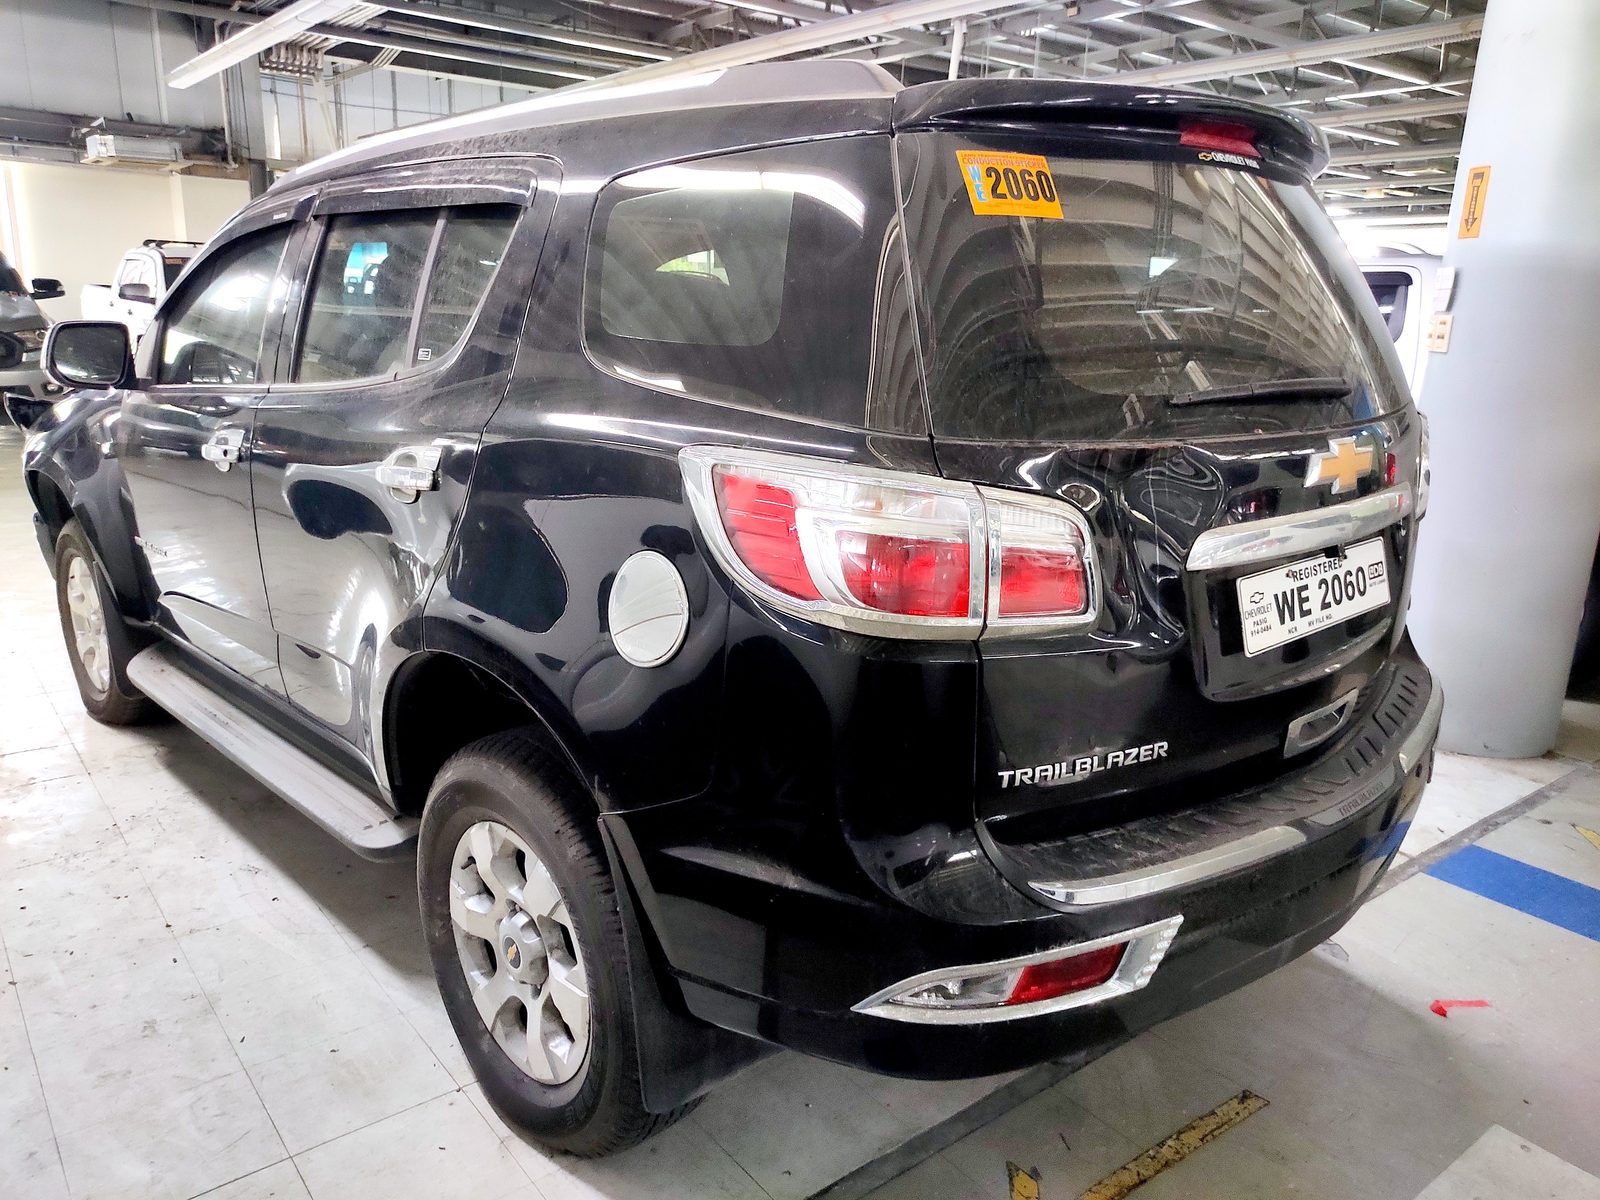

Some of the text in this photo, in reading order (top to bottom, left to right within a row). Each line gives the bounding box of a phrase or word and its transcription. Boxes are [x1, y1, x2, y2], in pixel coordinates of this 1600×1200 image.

[962, 157, 1014, 167] CONDUCTION
[985, 166, 1056, 203] 2060
[1245, 602, 1273, 620] CHEVROLET
[1273, 566, 1367, 626] WE 2060
[998, 741, 1168, 789] TRAILBLAZER
